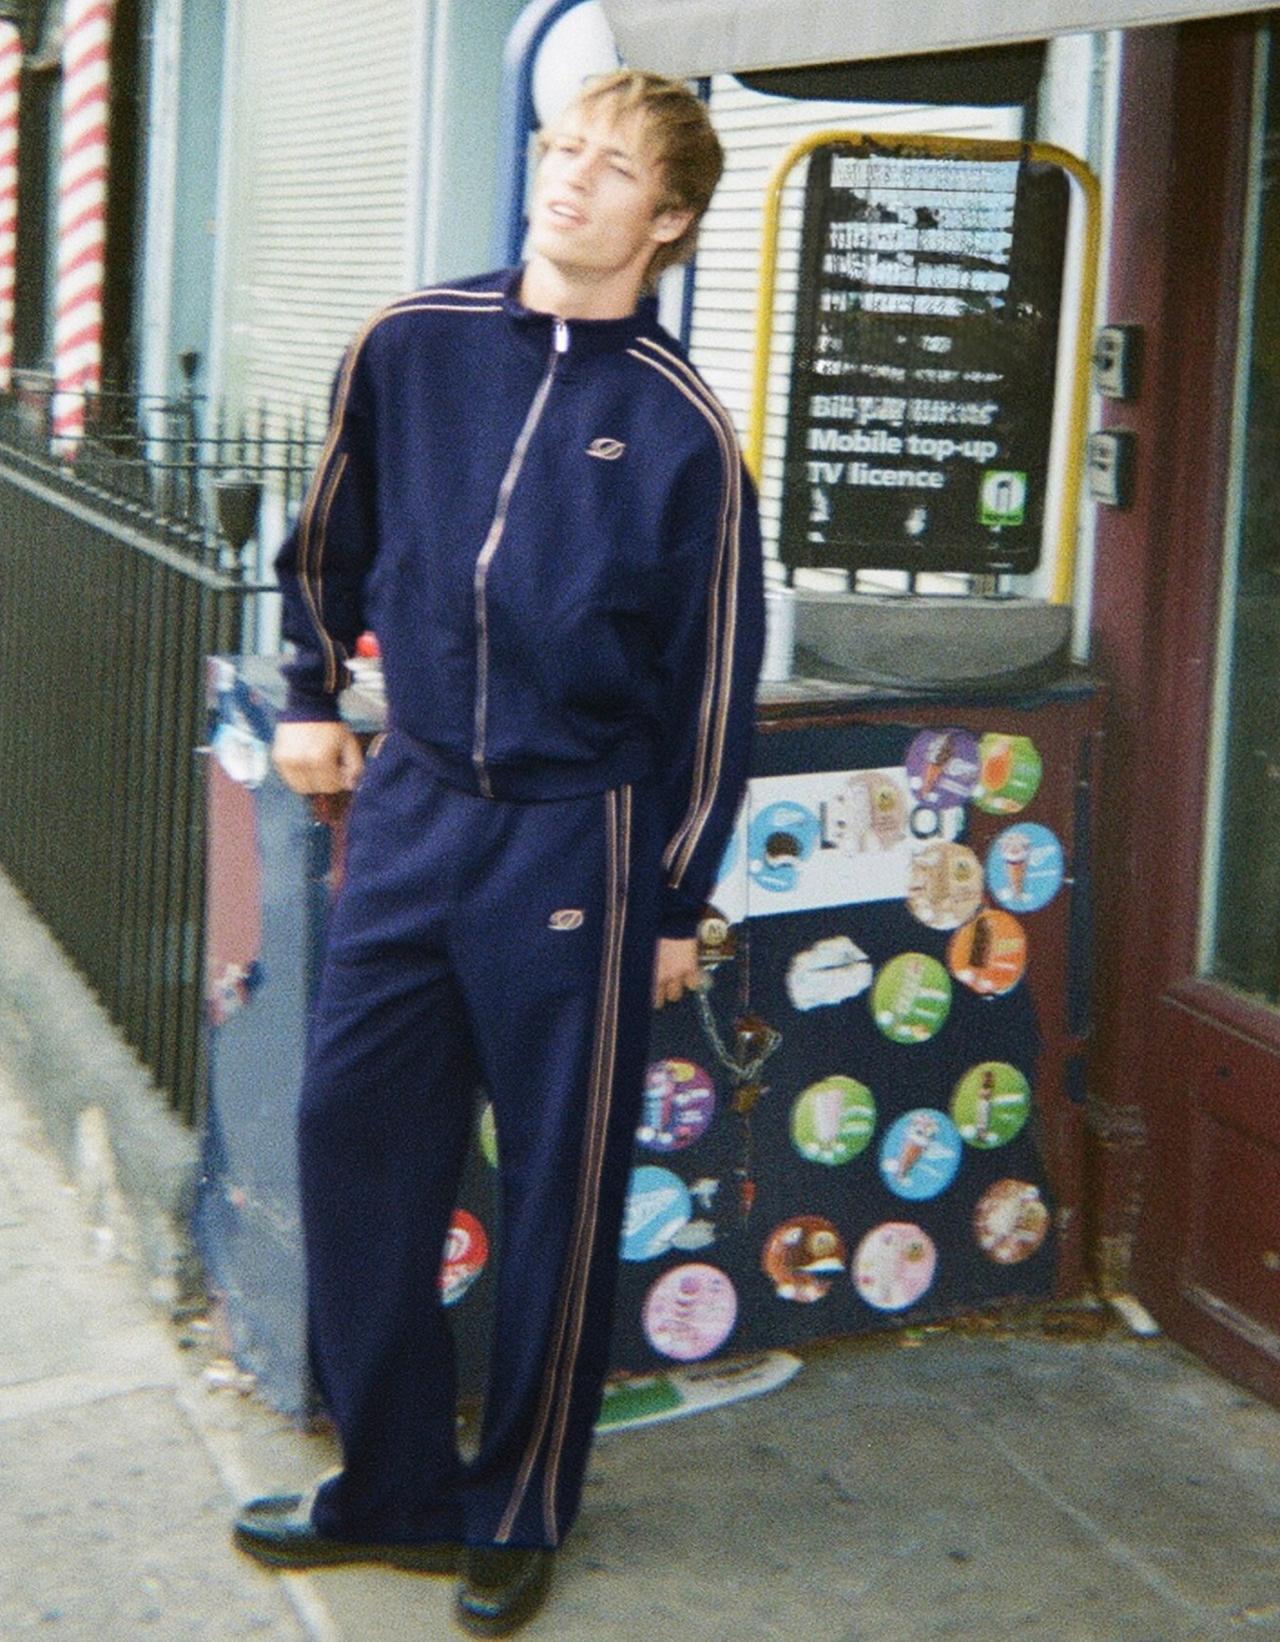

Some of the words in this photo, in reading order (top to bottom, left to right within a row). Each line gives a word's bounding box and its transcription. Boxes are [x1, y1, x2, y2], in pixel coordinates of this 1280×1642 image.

[808, 429, 903, 454] Mobile
[905, 434, 998, 462] top-up
[807, 462, 843, 484] TV
[847, 463, 944, 488] licence
